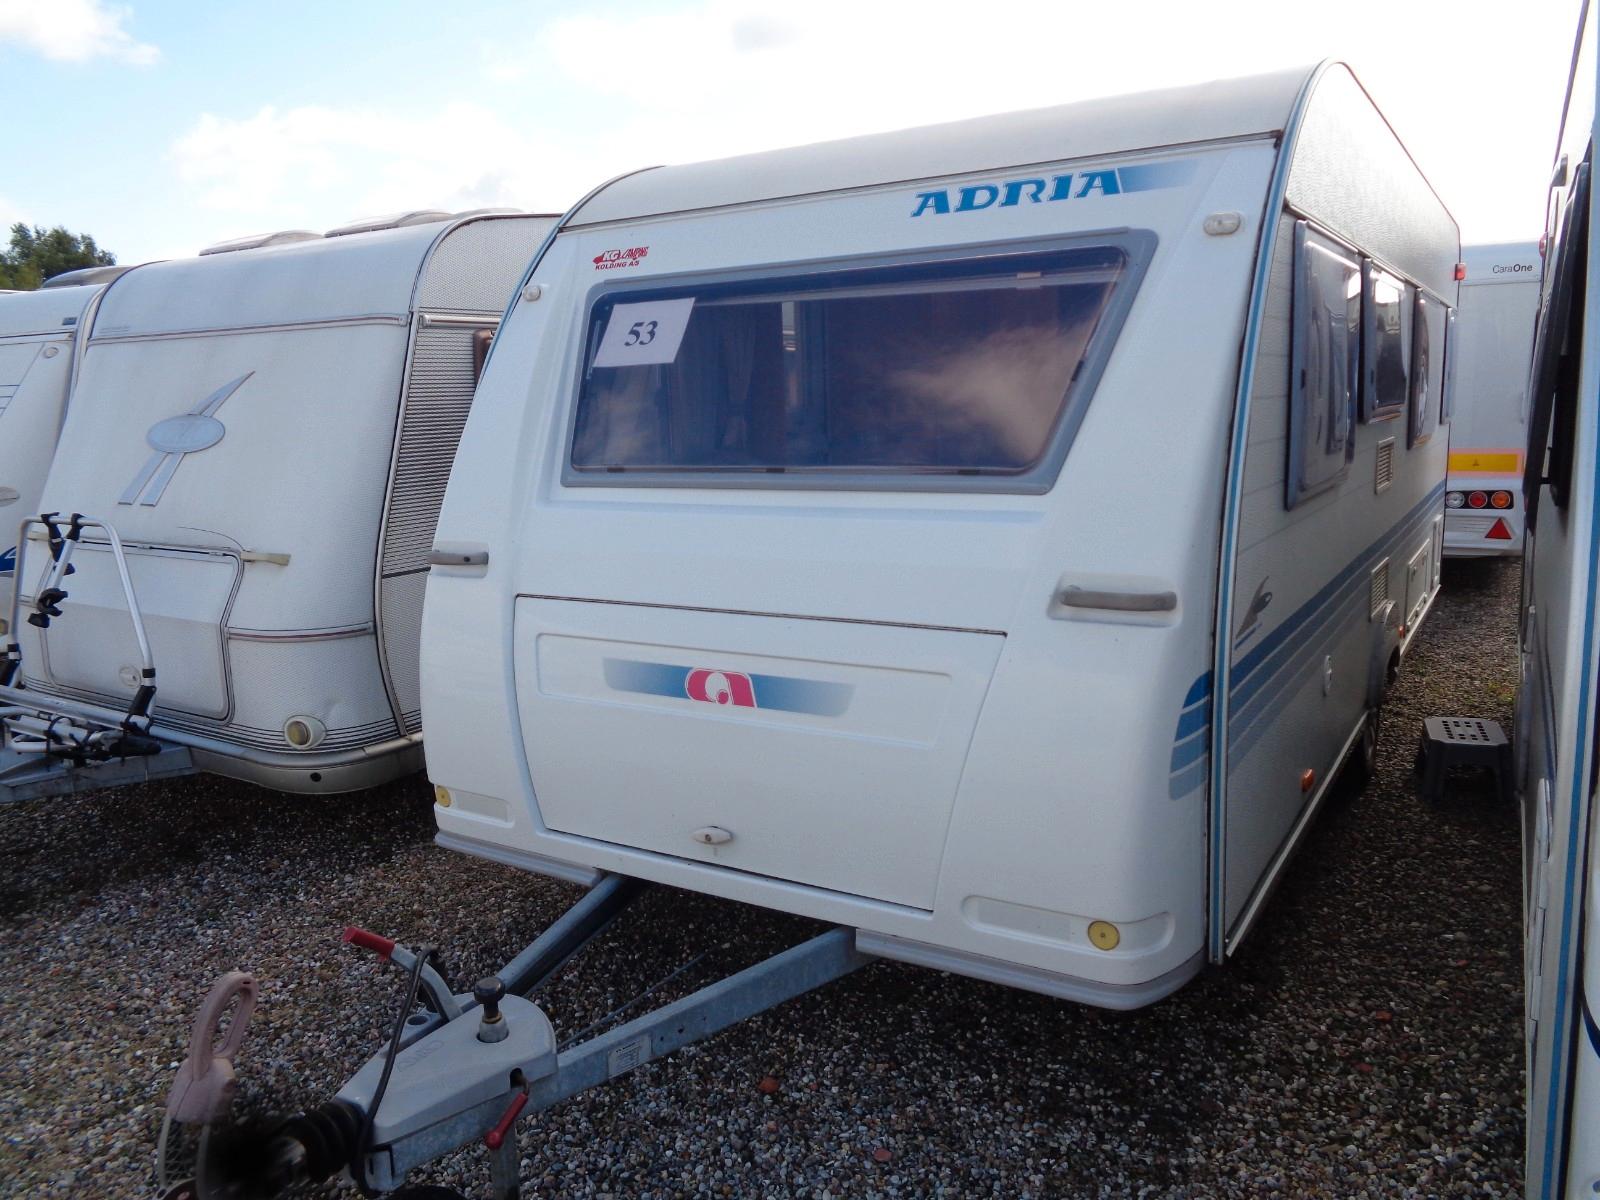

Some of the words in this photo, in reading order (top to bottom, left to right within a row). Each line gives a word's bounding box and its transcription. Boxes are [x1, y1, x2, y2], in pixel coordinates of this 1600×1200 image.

[909, 169, 1121, 217] ADRIA
[595, 261, 627, 270] KOLDING
[1492, 263, 1533, 274] CaraOne
[624, 320, 658, 347] 53
